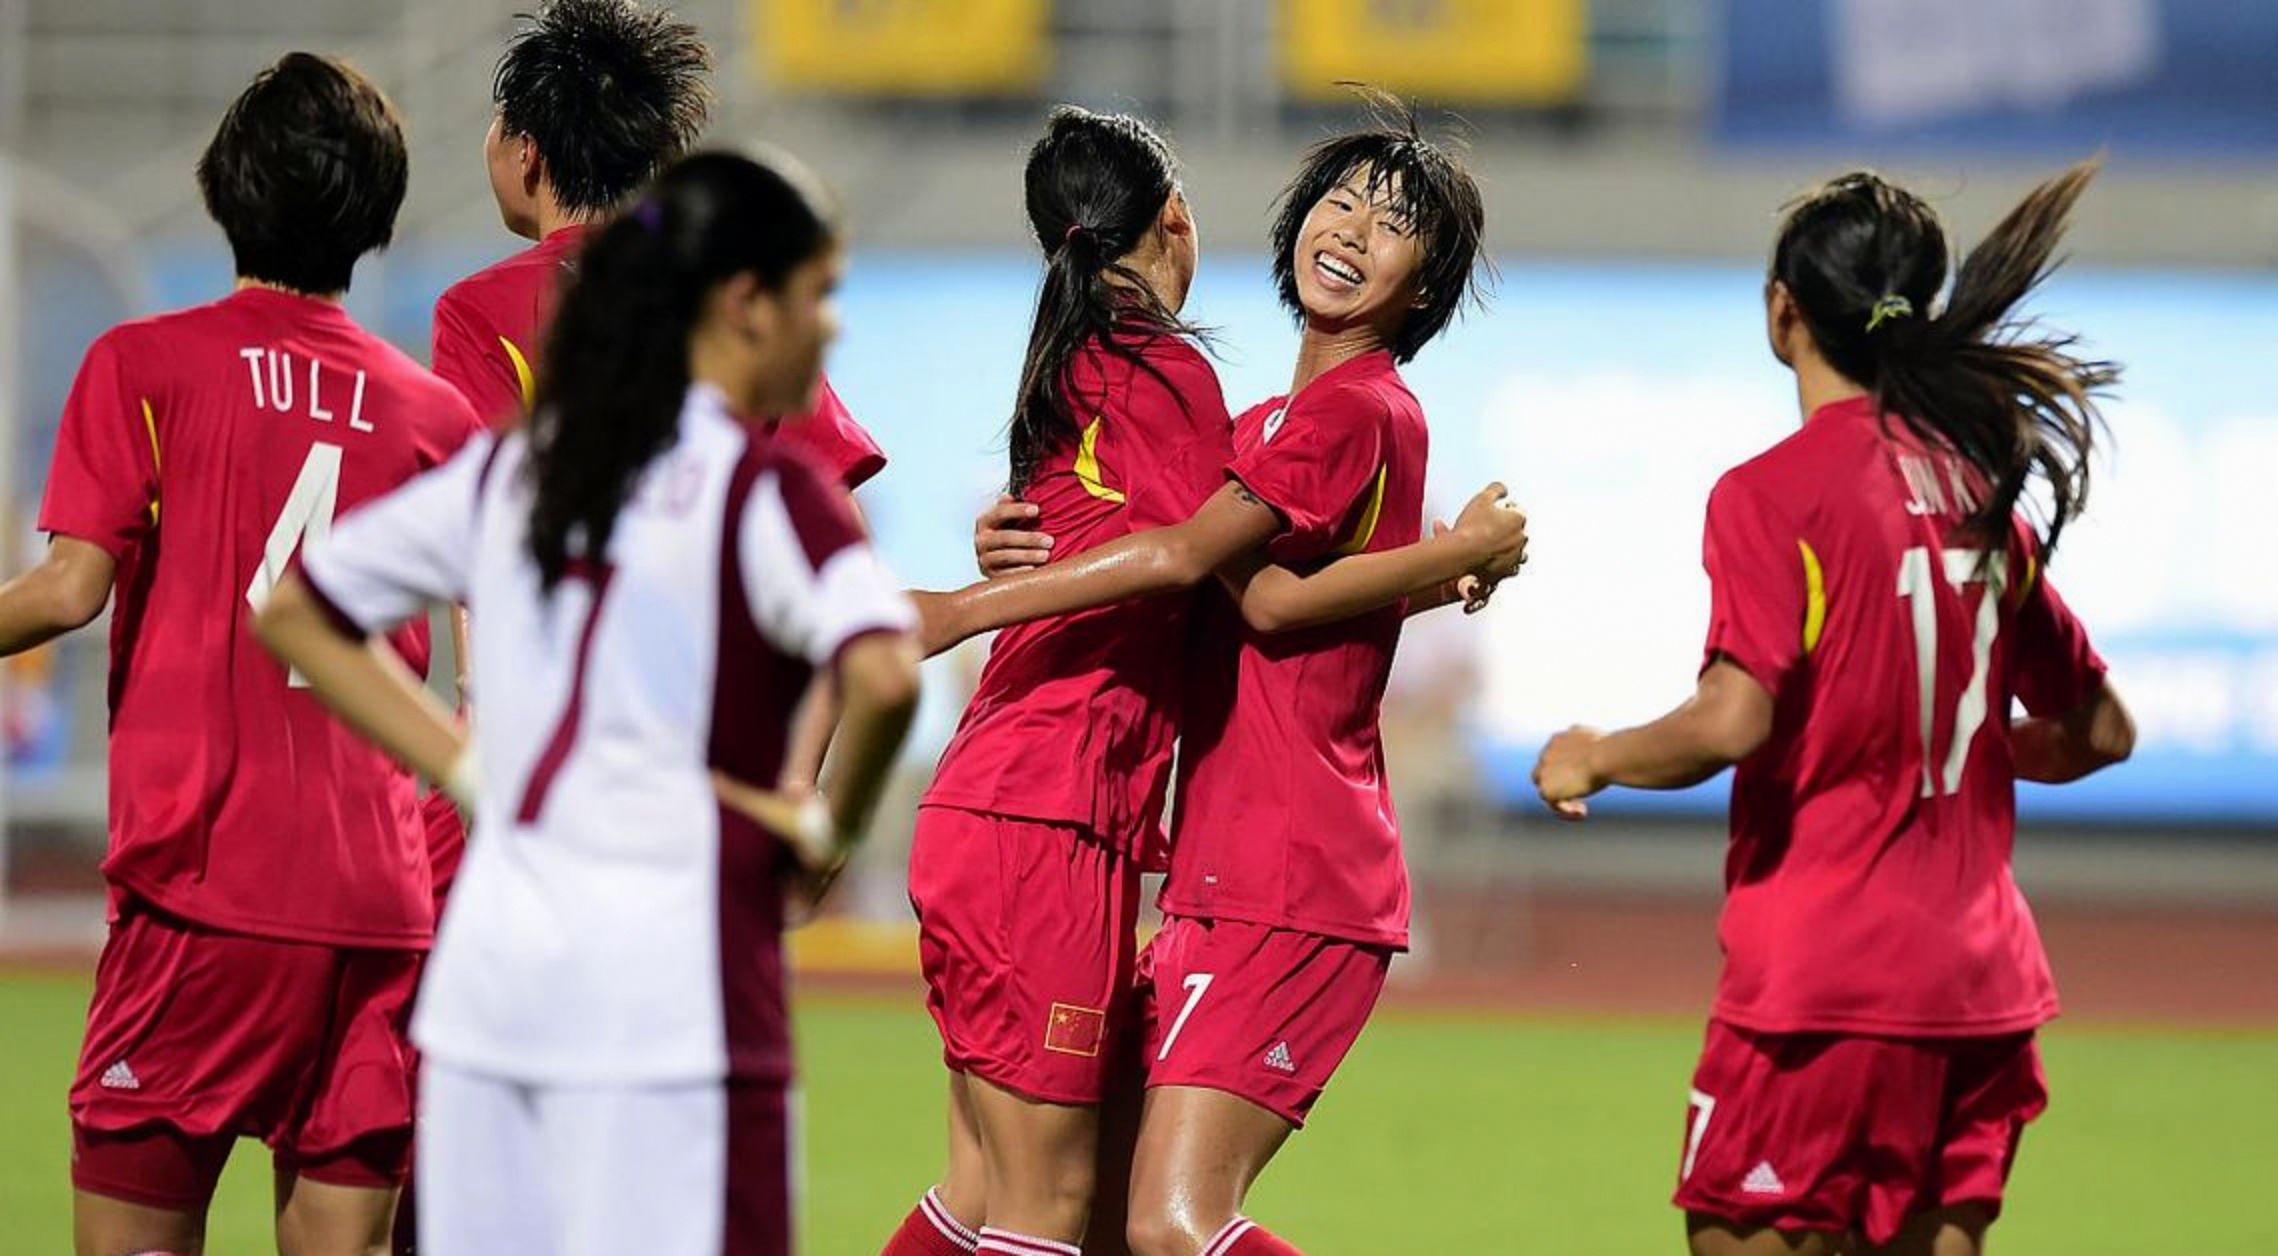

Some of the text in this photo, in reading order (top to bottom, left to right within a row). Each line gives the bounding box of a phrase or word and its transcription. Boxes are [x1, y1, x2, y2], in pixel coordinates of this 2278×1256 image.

[514, 555, 617, 824] 7
[1896, 546, 2009, 798] 17
[1157, 973, 1215, 1061] 7
